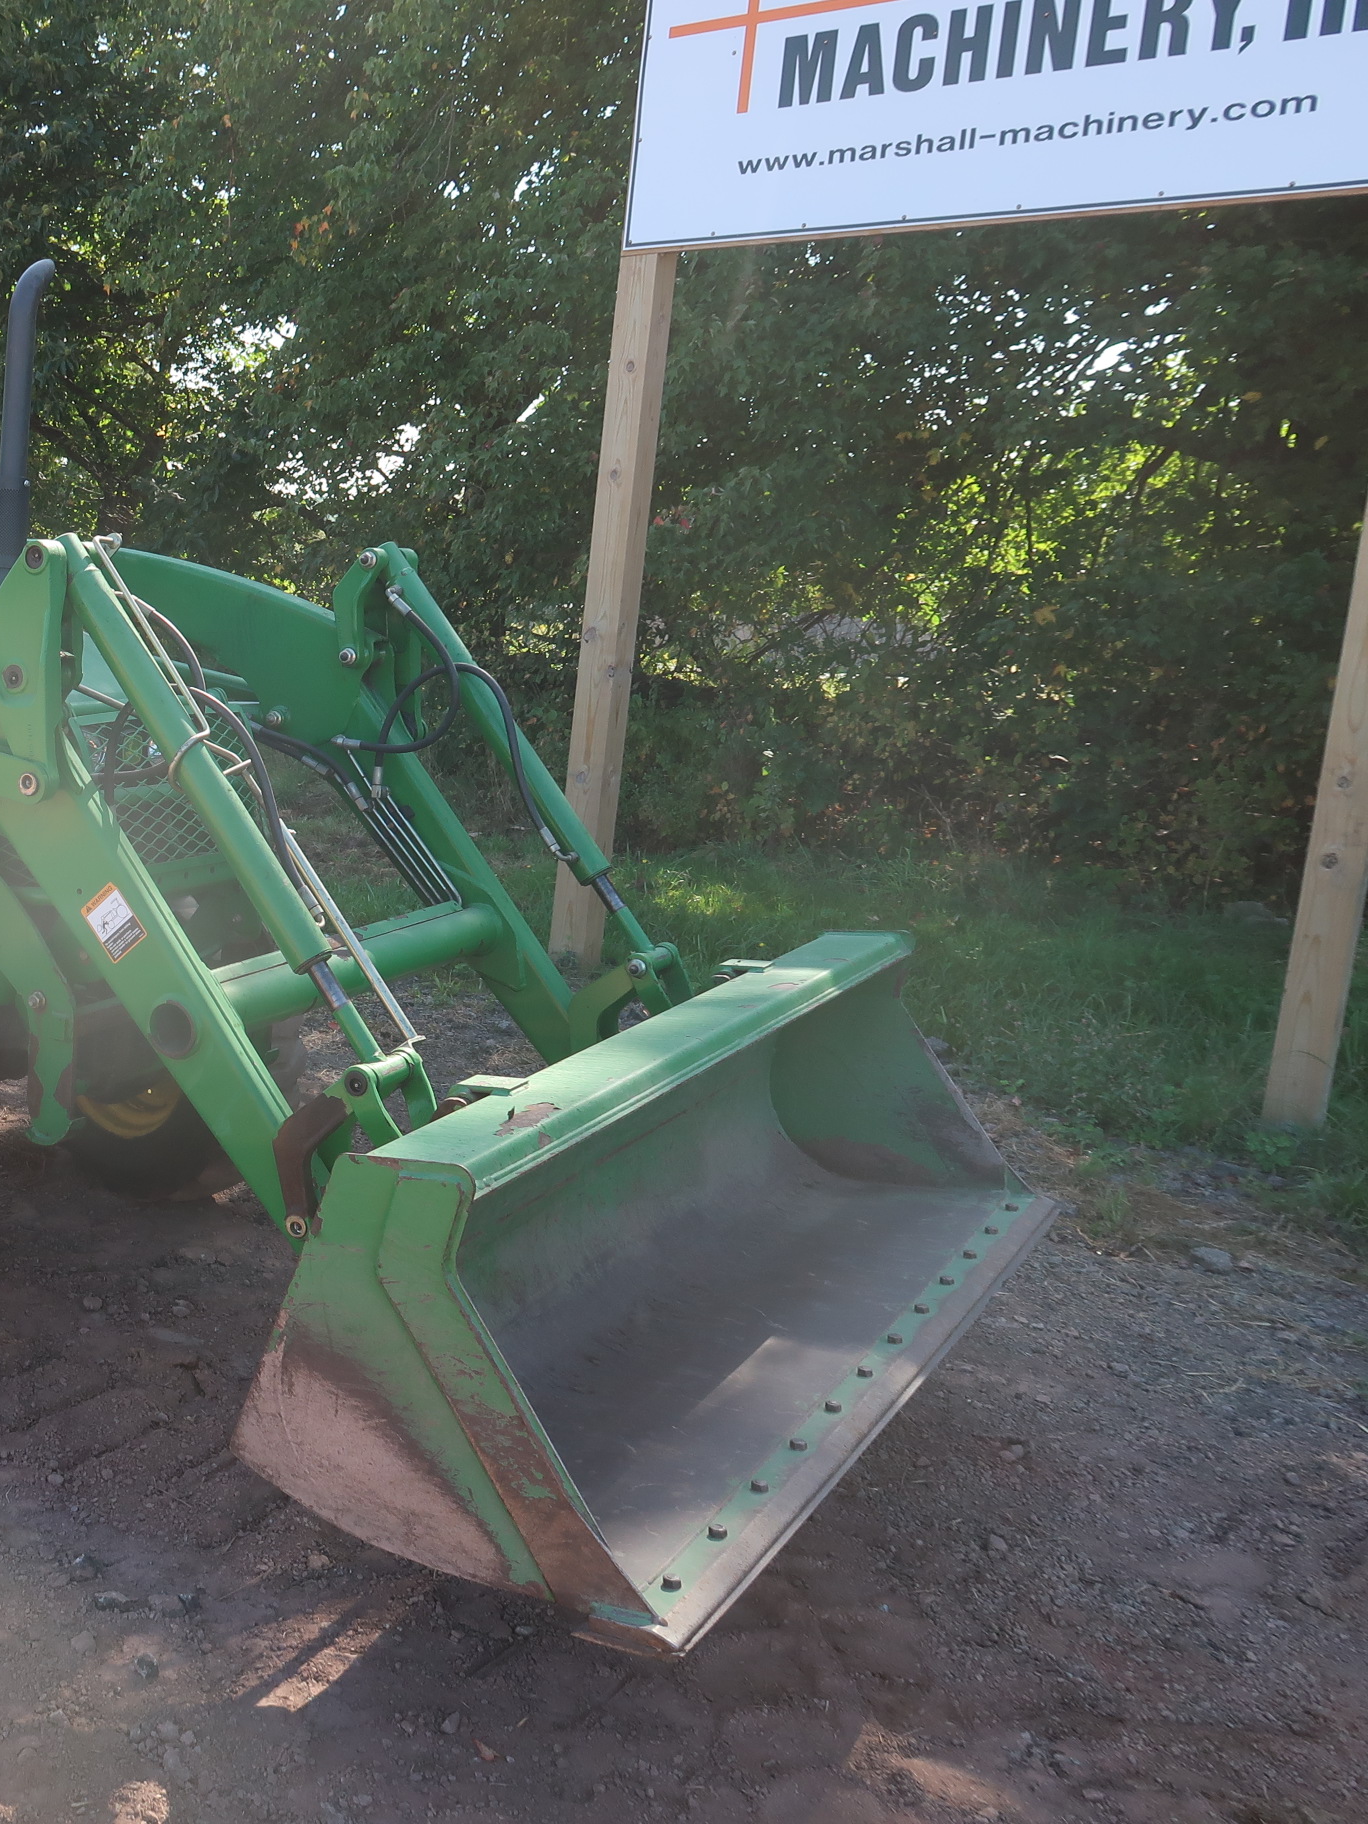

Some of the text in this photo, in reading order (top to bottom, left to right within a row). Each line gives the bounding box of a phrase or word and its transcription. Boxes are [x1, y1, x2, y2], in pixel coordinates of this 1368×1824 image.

[777, 0, 1257, 109] MACHINERY,
[738, 93, 1319, 174] www.marshall-machinery.com
[90, 885, 113, 907] WARNING
